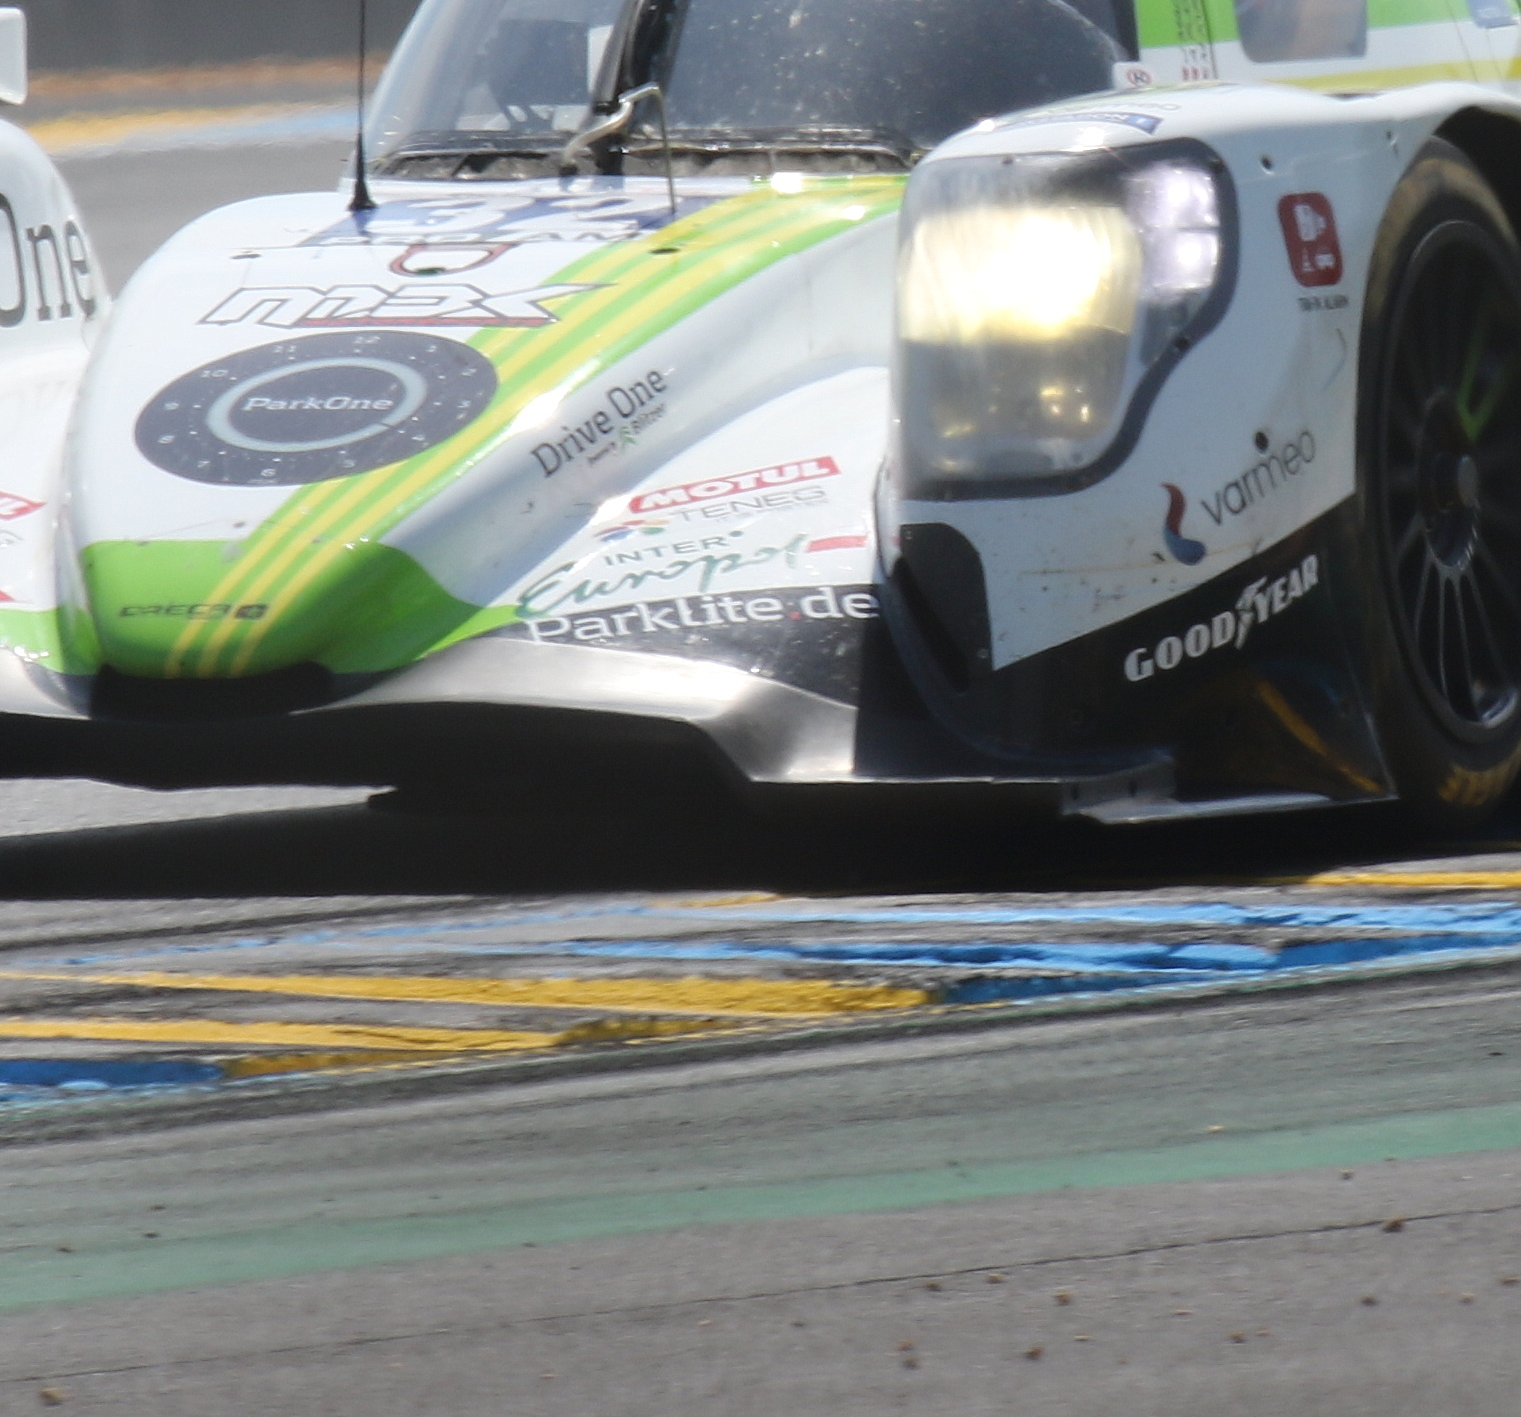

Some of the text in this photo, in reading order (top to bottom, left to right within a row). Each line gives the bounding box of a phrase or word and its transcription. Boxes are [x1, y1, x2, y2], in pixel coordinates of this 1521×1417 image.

[241, 396, 395, 412] ParkOne
[531, 410, 614, 478] Drive
[607, 370, 668, 419] One
[636, 461, 832, 511] MOTUL
[1199, 430, 1317, 527] varmeo
[515, 532, 808, 618] Europol
[604, 536, 728, 566] INTER
[525, 586, 880, 643] Parklite.de
[1123, 553, 1319, 682] GOODYEAR
